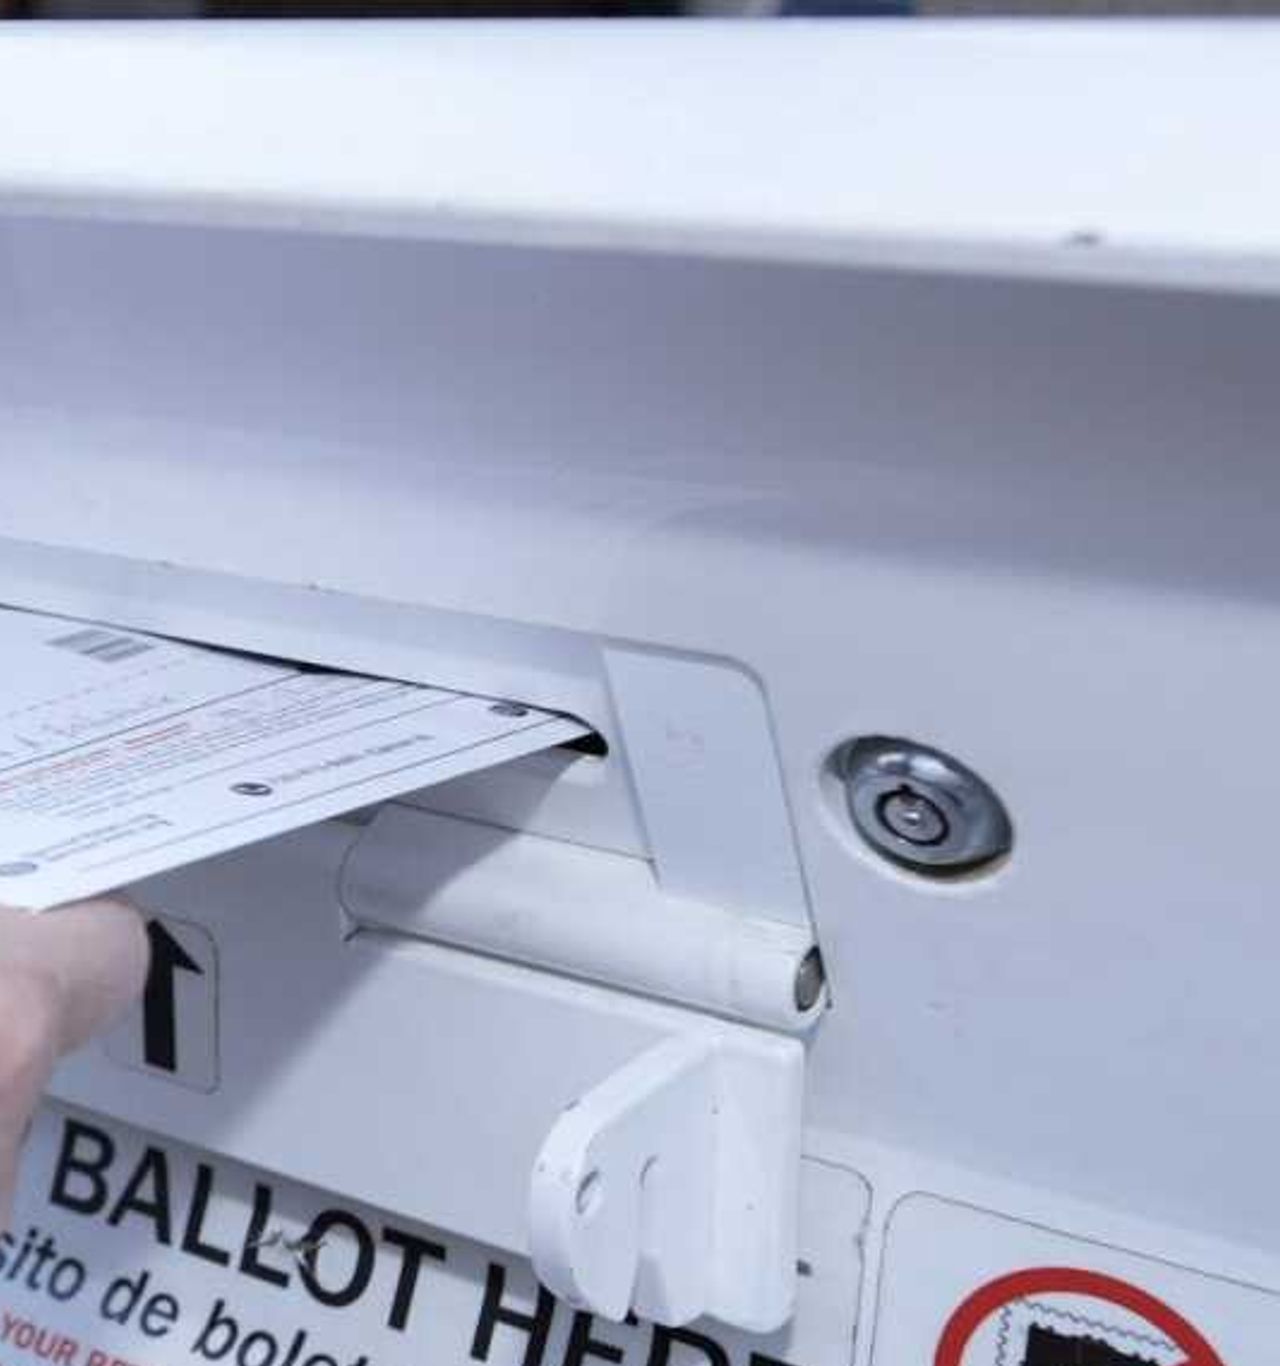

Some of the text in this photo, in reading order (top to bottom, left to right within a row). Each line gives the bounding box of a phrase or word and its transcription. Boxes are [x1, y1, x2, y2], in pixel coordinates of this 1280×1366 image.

[50, 1118, 446, 1331] BALLOT
[1, 1308, 80, 1366] YOUR
[100, 1269, 179, 1338] de
